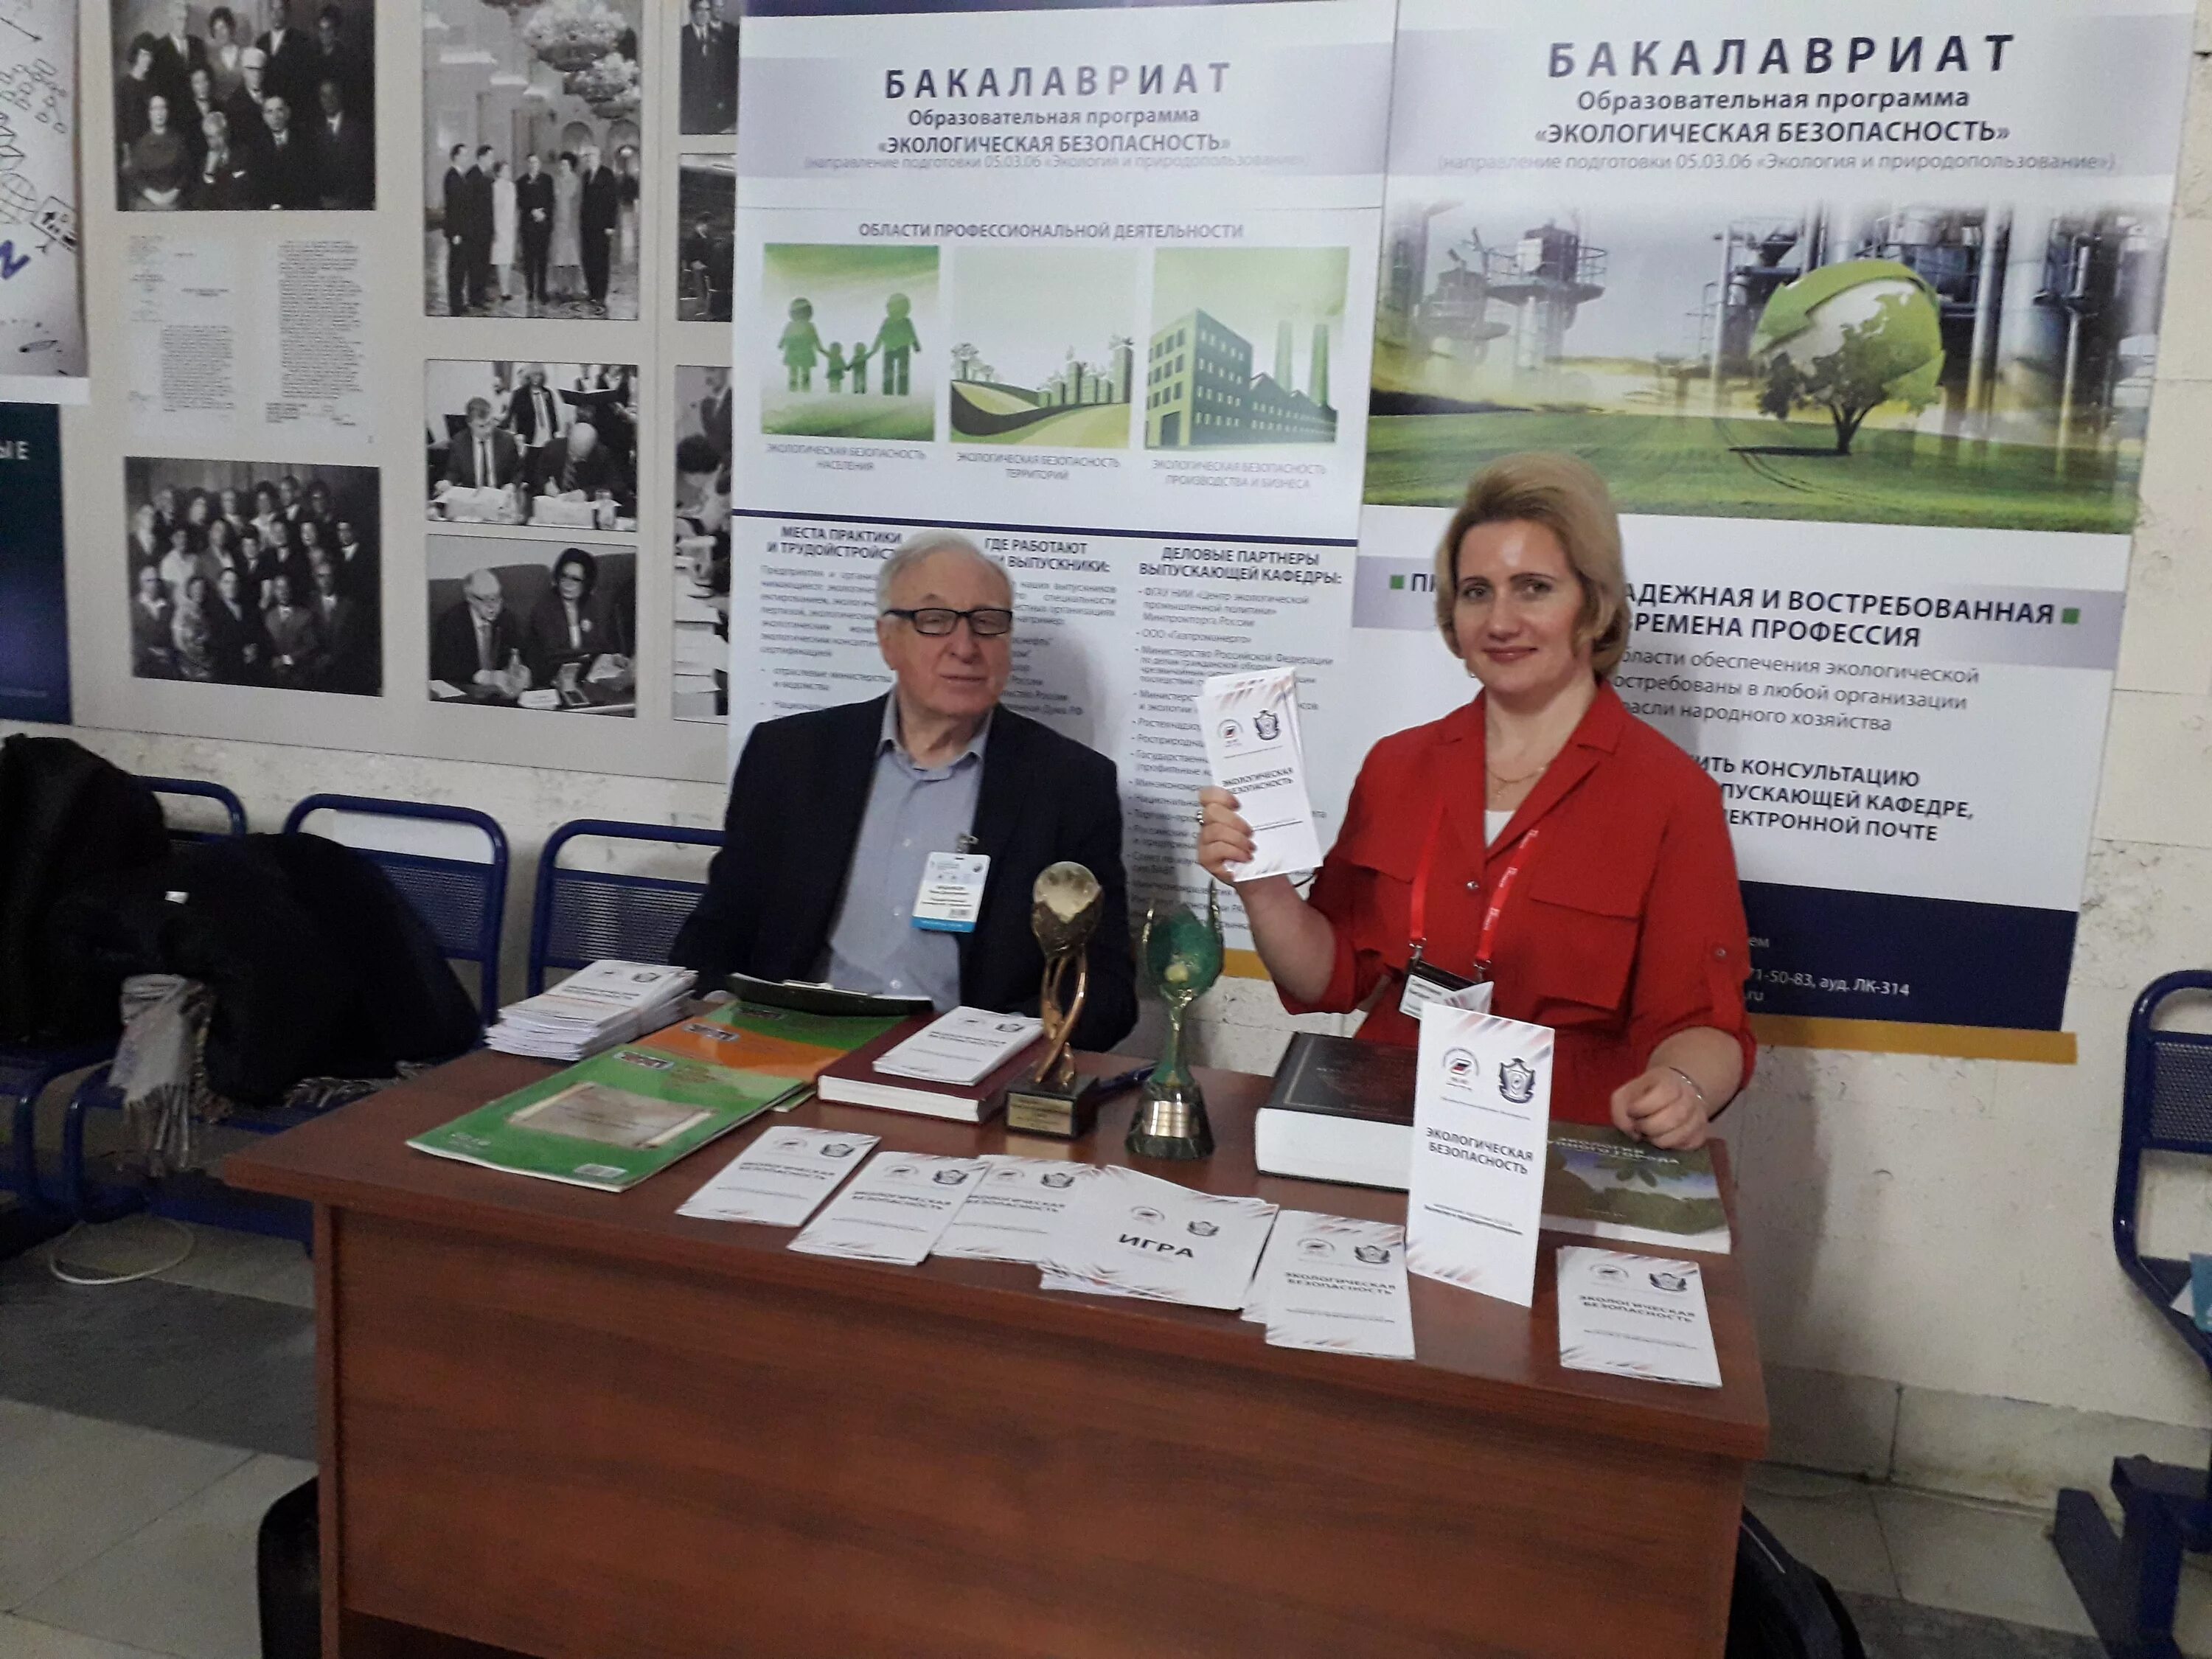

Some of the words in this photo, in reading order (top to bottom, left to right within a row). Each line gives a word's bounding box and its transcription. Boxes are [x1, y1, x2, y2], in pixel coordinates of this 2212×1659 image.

[1548, 33, 2014, 78] БАКАЛАВРИАТ
[885, 61, 1233, 100] БАКАЛАВРИАТ
[1577, 89, 1809, 111] Образовательная
[1816, 88, 1969, 112] программа
[908, 108, 1079, 127] Образовательная
[1088, 108, 1200, 128] программа
[878, 136, 1052, 154] «ЭКОЛОГИЧЕСКАЯ
[1060, 133, 1230, 153] БЕЗОПАСНОСТЬ»
[1535, 121, 1770, 144] «ЭКОЛОГИЧЕСКАЯ
[1778, 119, 2010, 143] БЕЗОПАСНОСТЬ»
[903, 155, 981, 170] подготовки
[985, 154, 1041, 169] 05.03.06
[1120, 156, 1127, 167] и
[1565, 154, 1671, 171] подготовки
[1675, 153, 1751, 169] 05.03.06
[1756, 153, 1854, 170] «Экология
[1861, 156, 1871, 167] и
[859, 222, 930, 237] ОБЛАСТИ
[935, 222, 1110, 239] ПРОФЕССИОНАЛЬНОЙ
[1113, 223, 1243, 240] ДЕЯТЕЛЬНОСТИ
[782, 526, 827, 540] МЕСТА
[830, 528, 901, 543] ПРАКТИКИ
[985, 538, 1009, 552] ГДЕ
[1012, 539, 1088, 554] РАБОТАЮТ
[767, 541, 776, 552] И
[779, 542, 897, 559] ТРУДОЙСТРОЙС
[1161, 546, 1234, 563] ДЕЛОВЫЕ
[1237, 549, 1320, 566] ПАРТНЕРЫ
[1138, 563, 1258, 582] ВЫПУСКАЮЩЕЙ
[1262, 568, 1342, 584] КАФЕДРЫ:
[1625, 582, 1754, 608] АДЕЖНАЯ
[1761, 589, 1781, 609] И
[1788, 590, 2055, 625] ВОСТРЕБОВАННАЯ
[1634, 612, 1742, 638] РЕМЕНА
[1750, 617, 1921, 648] ПРОФЕССИЯ
[1691, 650, 1820, 674] обеспечения
[1826, 661, 1979, 684] экологической
[1614, 673, 1742, 695] остребованы
[1748, 683, 1758, 696] в
[1763, 683, 1829, 701] любой
[1834, 689, 1967, 710] организации
[1680, 706, 1786, 723] народного
[1790, 712, 1891, 731] хозяйства
[1742, 759, 1920, 789] КОНСУЛЬТАЦИЮ
[1721, 783, 1860, 810] ПУСКАЮЩЕЙ
[1866, 794, 1974, 821] КАФЕДРЕ,
[1728, 810, 1860, 835] ЕКТРОННОЙ
[1865, 820, 1938, 842] ПОЧТЕ
[1852, 978, 1910, 996] ЛК-314
[1426, 1127, 1534, 1162] ЭКОЛОГИЧЕСКАЯ
[1428, 1141, 1528, 1175] БЕЗОПАСНОСТЬ
[1118, 1233, 1194, 1259] ИГРА
